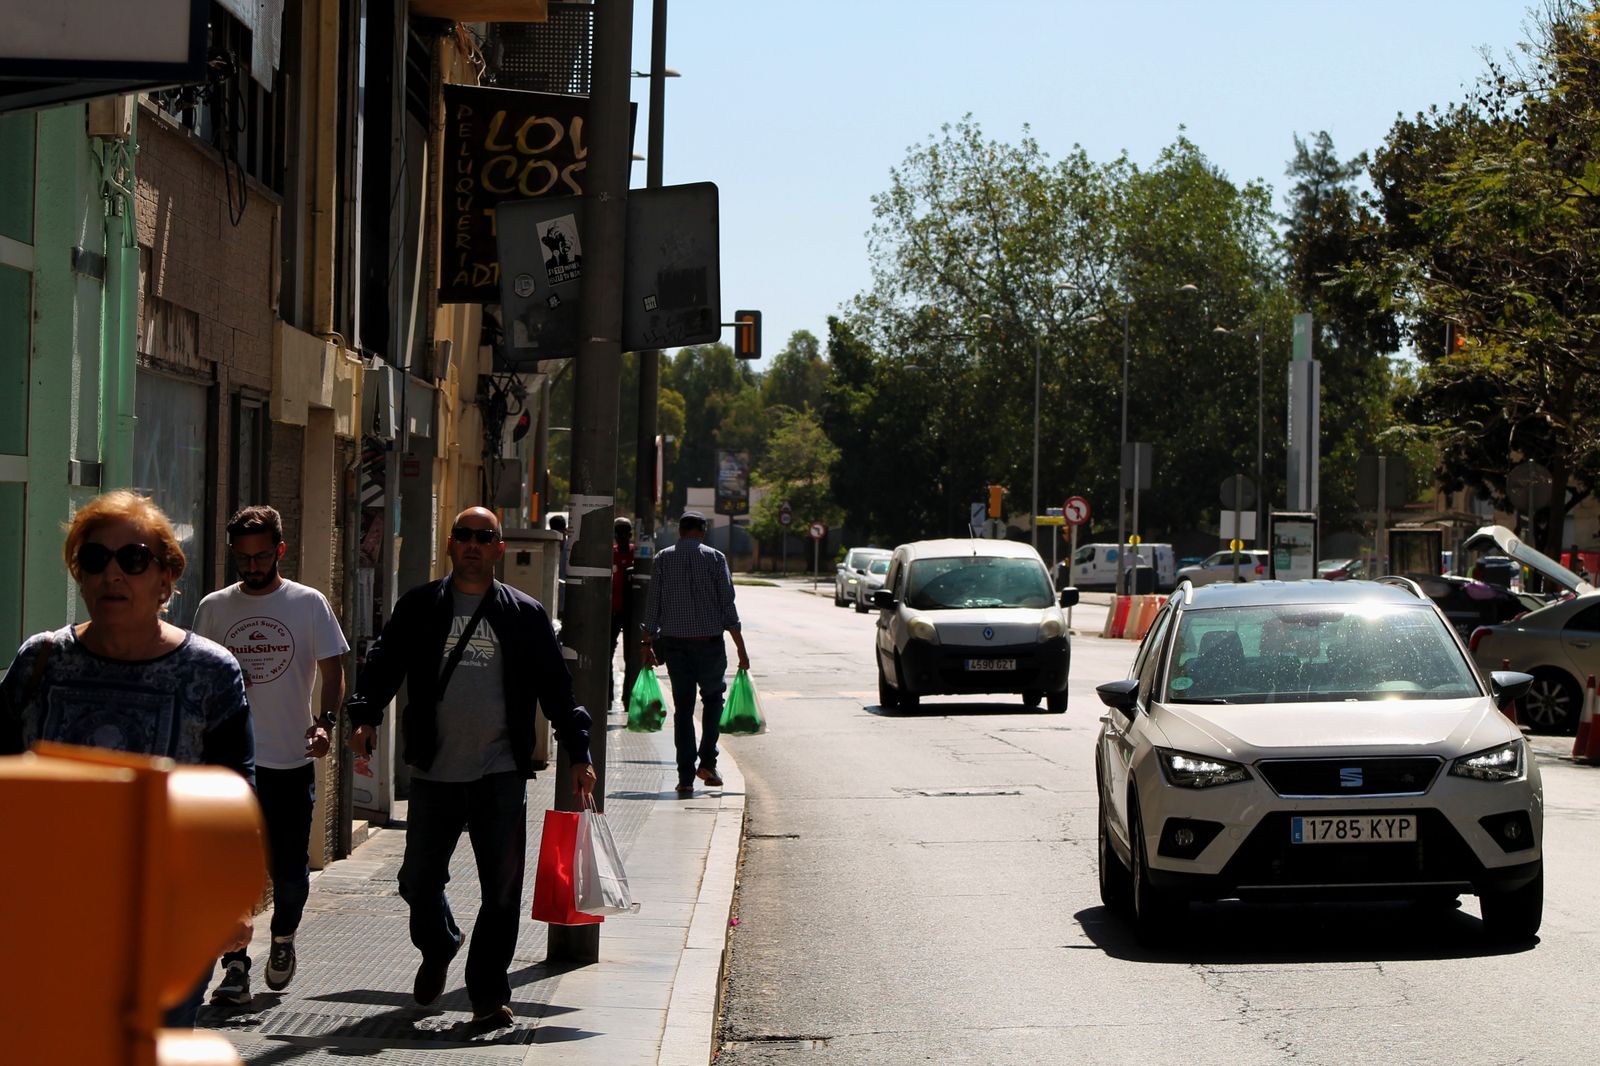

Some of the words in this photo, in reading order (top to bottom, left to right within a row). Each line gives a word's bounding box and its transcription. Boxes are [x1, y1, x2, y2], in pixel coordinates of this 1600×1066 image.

[452, 103, 474, 287] PELUQUERIA
[230, 620, 258, 639] Original
[260, 620, 278, 630] Surf
[277, 627, 286, 637] Co
[1310, 819, 1361, 840] 1785
[1370, 818, 1410, 839] KYP
